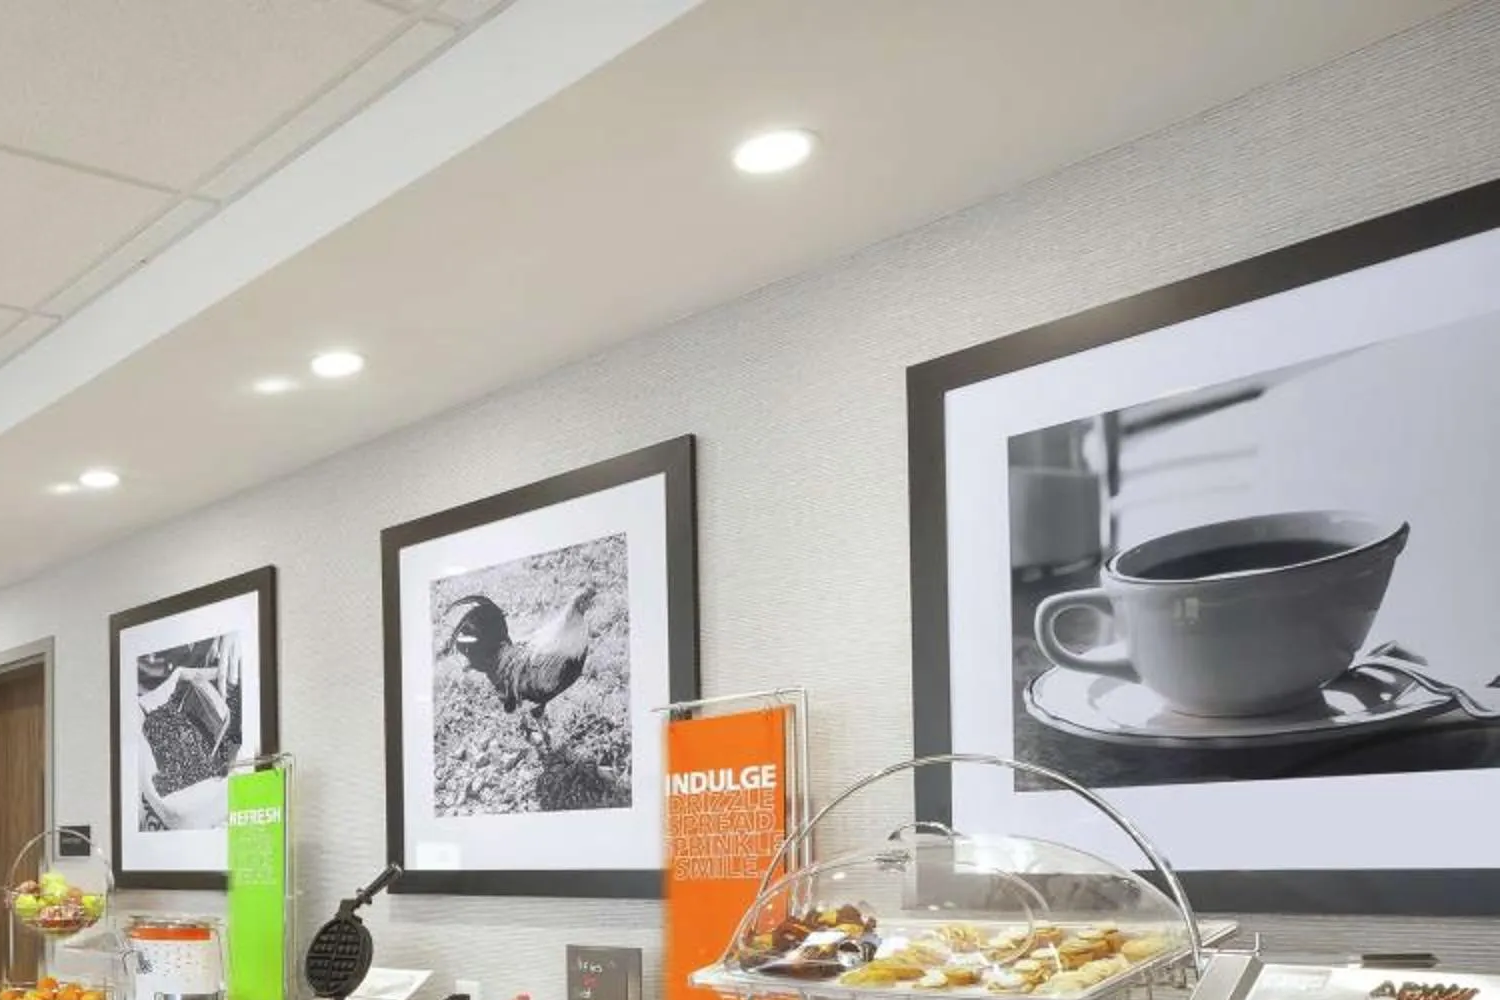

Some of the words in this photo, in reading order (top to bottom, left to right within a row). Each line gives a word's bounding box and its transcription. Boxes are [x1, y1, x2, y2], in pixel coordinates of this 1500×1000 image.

[665, 764, 777, 796] INDULGE
[668, 788, 775, 815] DRIZZLE
[667, 810, 777, 836] SPREAD
